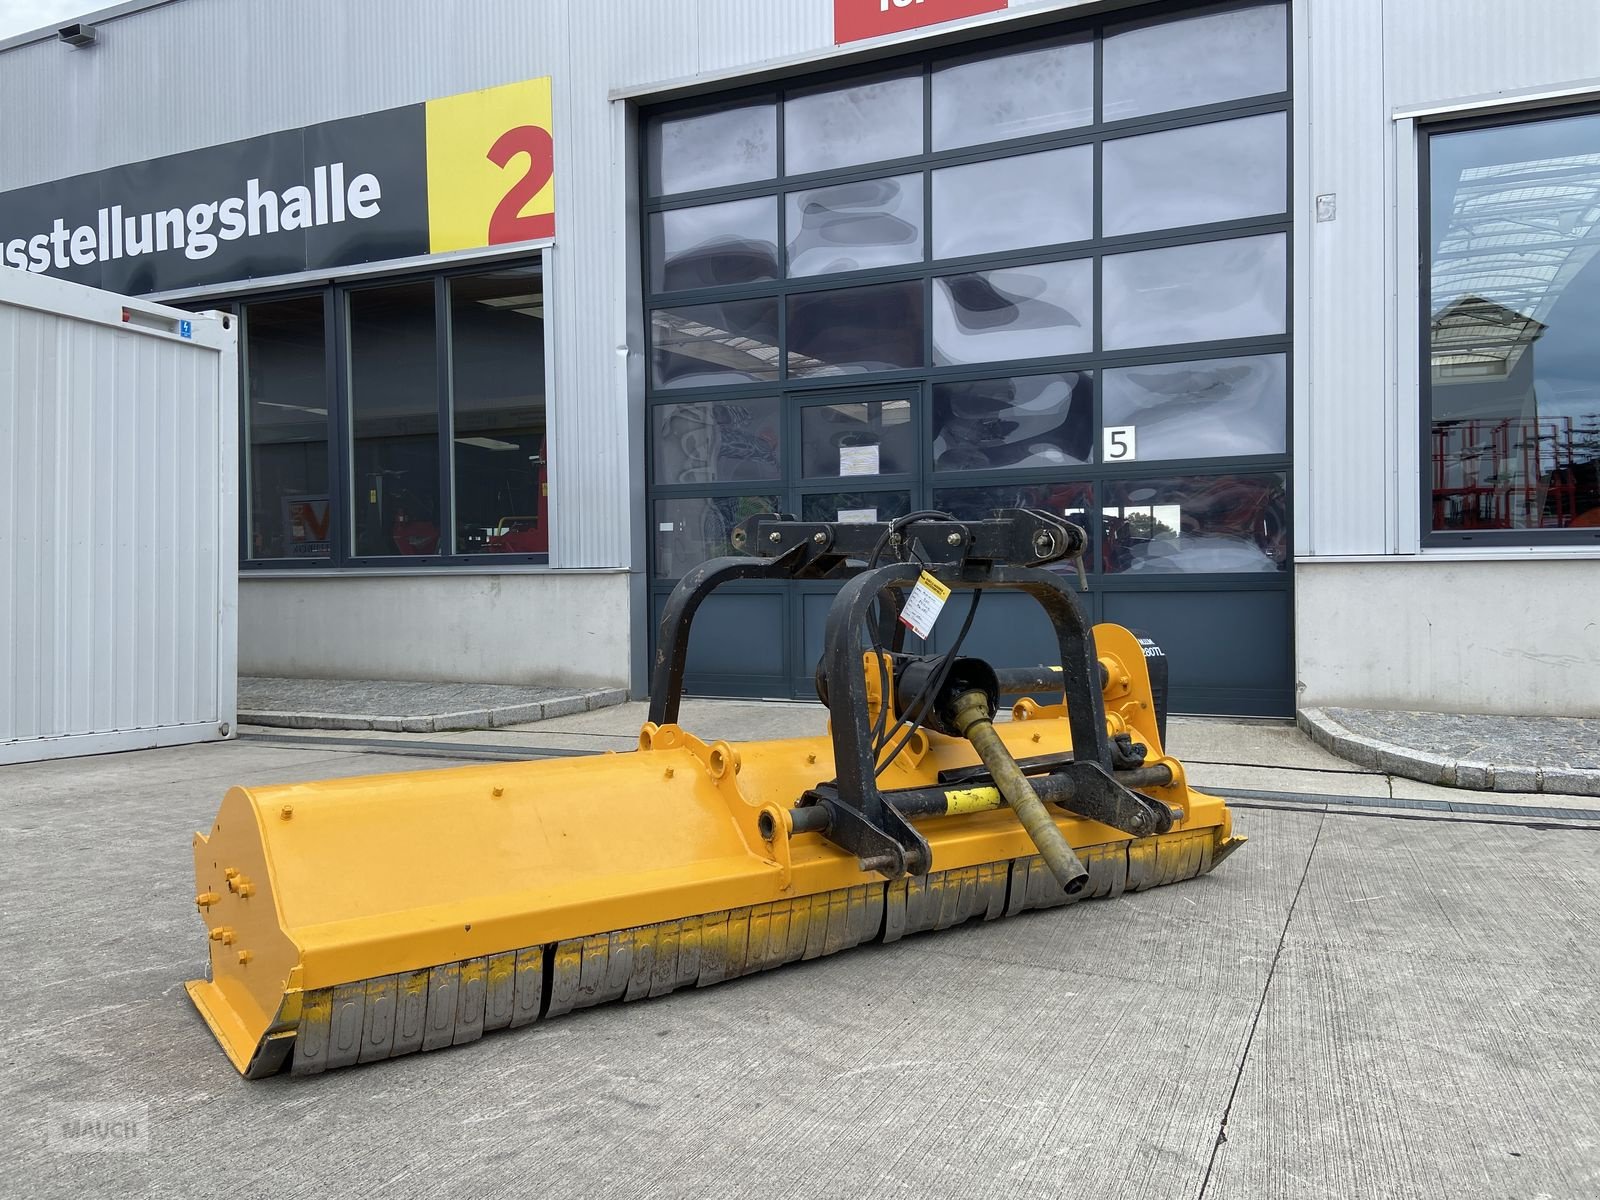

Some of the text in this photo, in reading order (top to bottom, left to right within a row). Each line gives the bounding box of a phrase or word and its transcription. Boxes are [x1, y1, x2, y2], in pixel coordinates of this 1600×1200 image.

[0, 125, 555, 272] sstellungshalle 2
[1110, 431, 1128, 458] 5
[1143, 646, 1165, 657] 80TL
